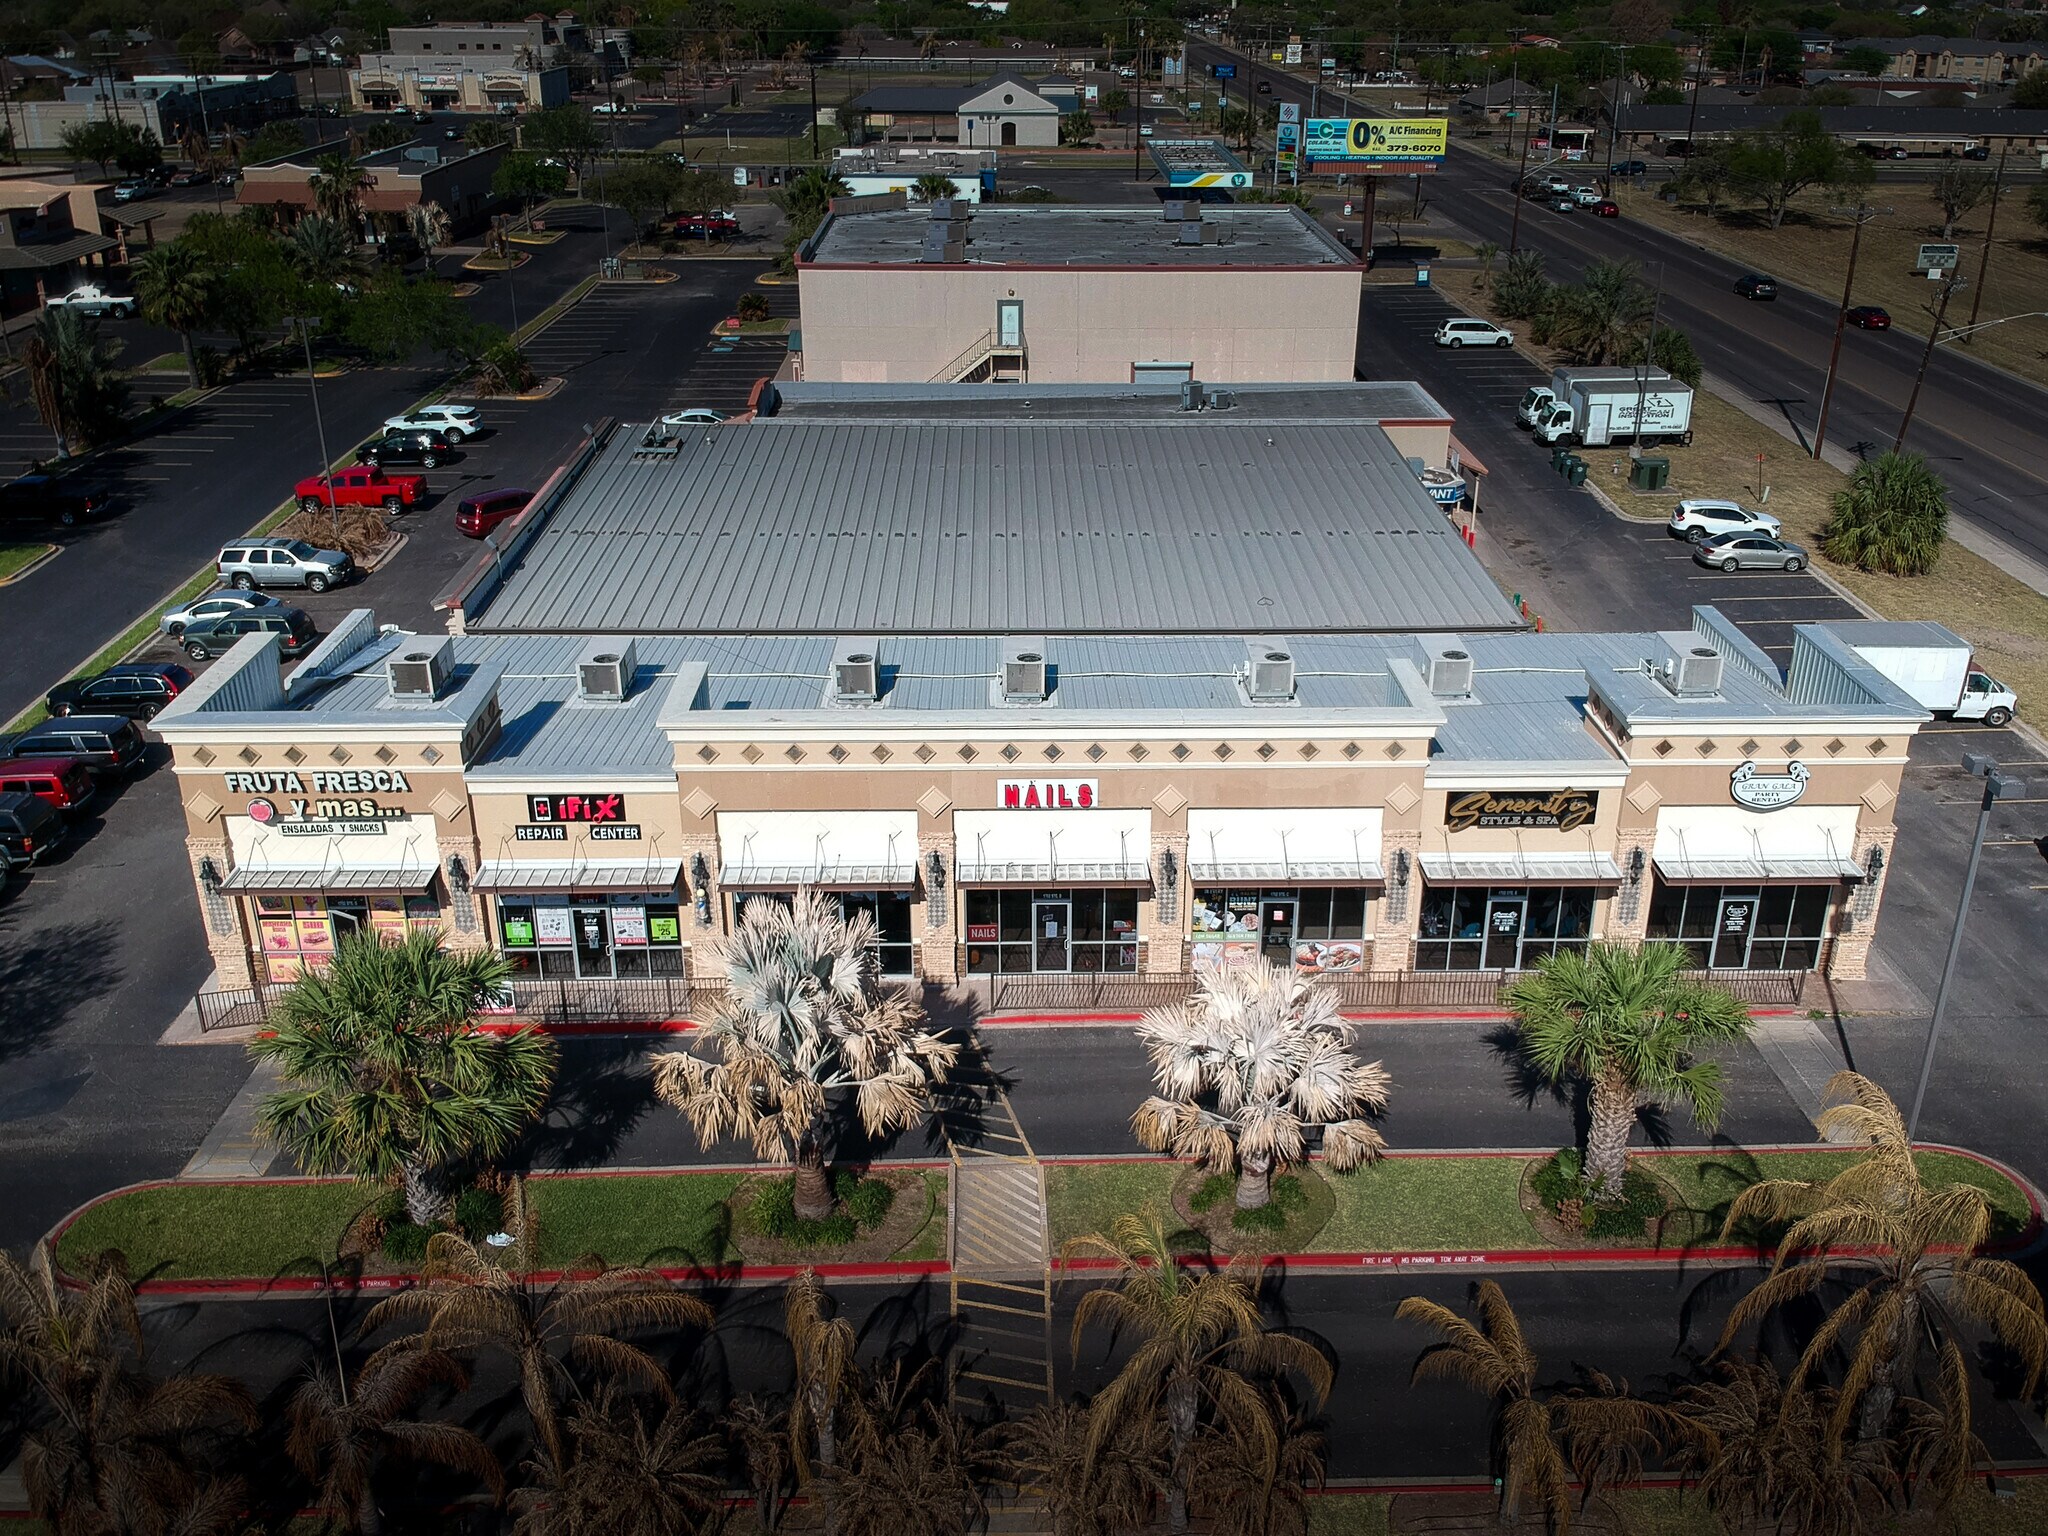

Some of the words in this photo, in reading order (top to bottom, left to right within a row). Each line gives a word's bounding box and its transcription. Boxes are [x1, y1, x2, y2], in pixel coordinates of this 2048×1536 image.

[1353, 121, 1386, 149] 0%
[1389, 126, 1403, 135] A/C
[1404, 126, 1442, 137] Financing
[224, 771, 304, 793] FRUTA
[312, 771, 411, 793] FRESCA
[1004, 784, 1093, 809] NAILS
[316, 799, 402, 818] mas...
[1448, 786, 1596, 833] Serenity
[1480, 816, 1520, 825] STYLE
[1523, 816, 1534, 825] &
[1536, 816, 1559, 825] SPA
[281, 824, 334, 834] ENSALADAS
[340, 823, 347, 833] Y
[349, 823, 380, 833] SNACKS
[517, 827, 564, 840] REPAIR
[591, 827, 640, 840] CENTER
[971, 928, 996, 938] NAILS
[1378, 1256, 1393, 1264] LANE
[1401, 1256, 1409, 1264] NO
[1412, 1256, 1435, 1264] PARKING
[1470, 1255, 1485, 1263] ZONE
